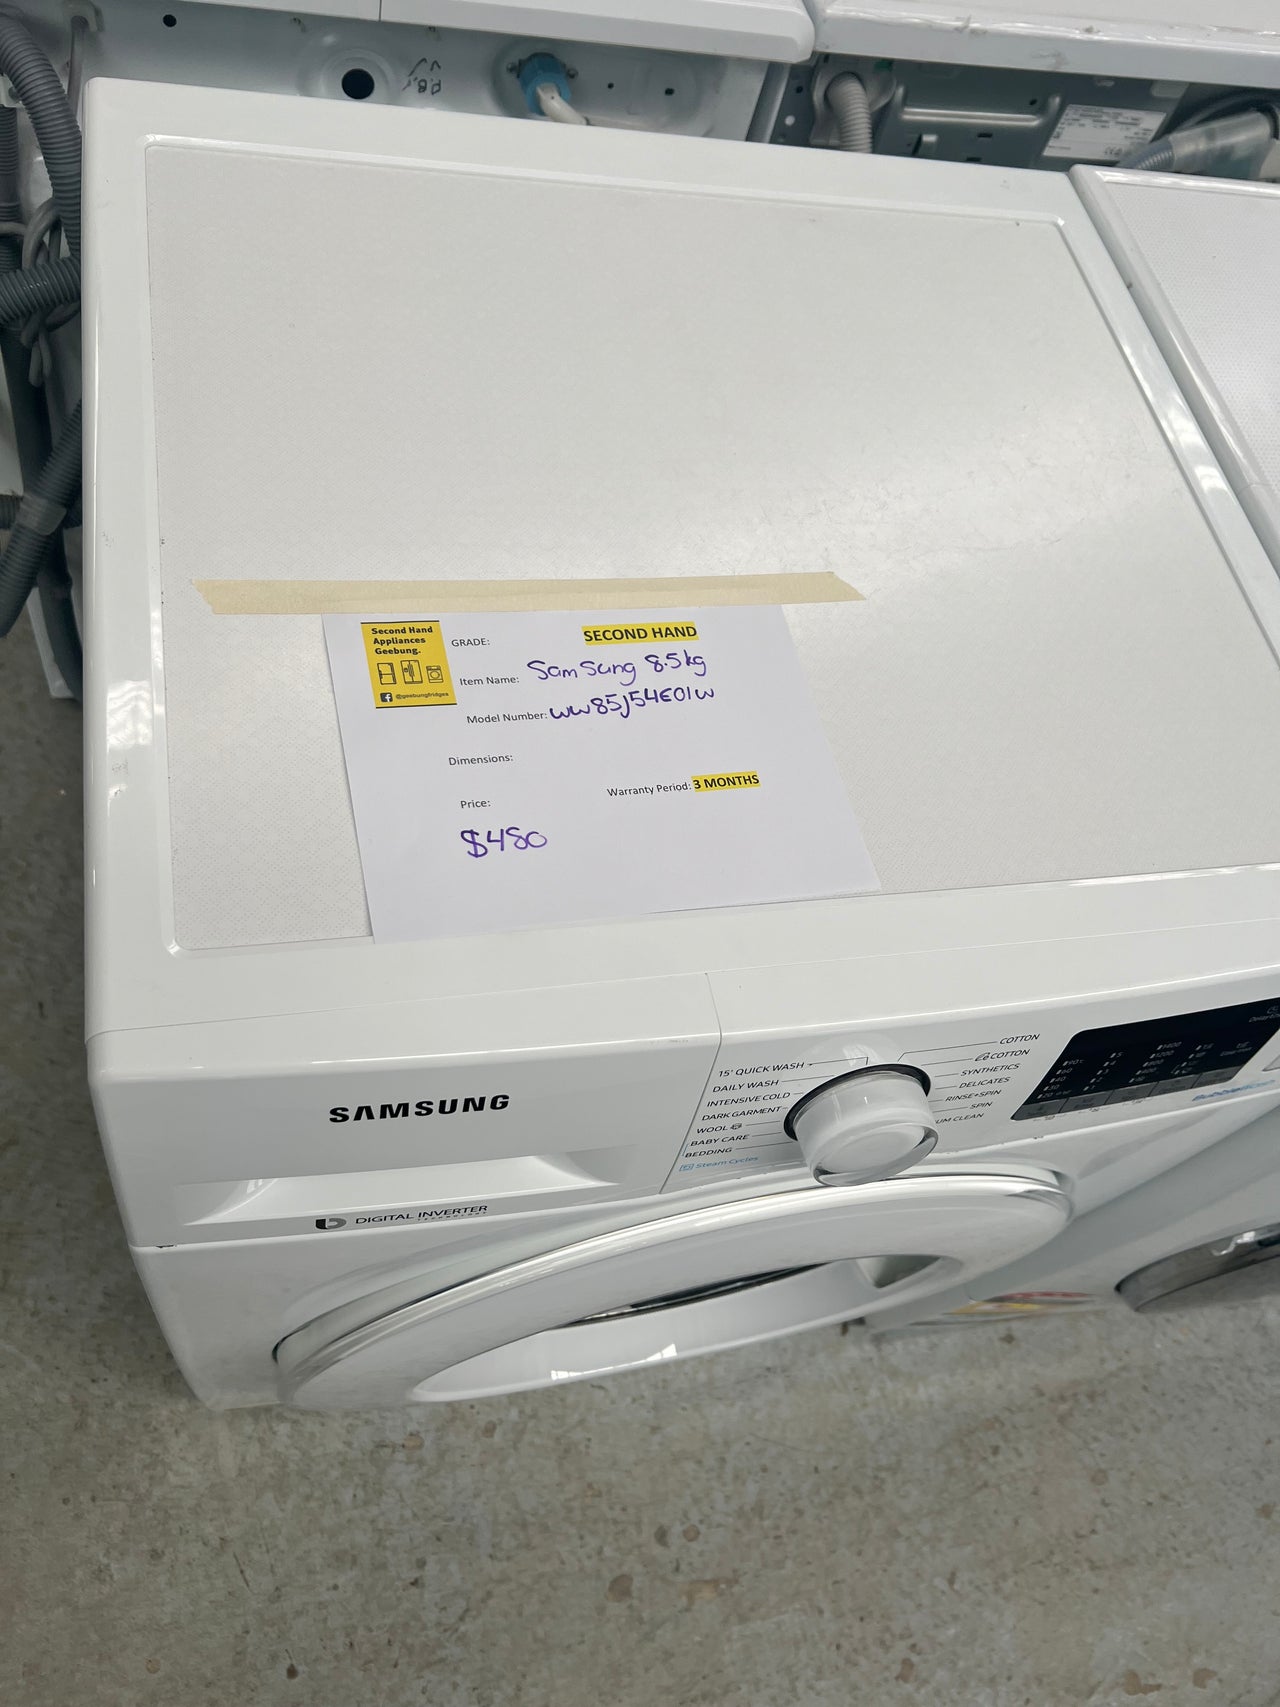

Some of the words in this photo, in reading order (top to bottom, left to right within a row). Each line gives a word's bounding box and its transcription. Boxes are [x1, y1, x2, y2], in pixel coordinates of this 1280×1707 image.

[371, 627, 407, 635] Second
[408, 626, 433, 634] Hand
[583, 627, 648, 642] SECOND
[651, 625, 697, 639] HAND
[373, 637, 426, 646] Appliances
[451, 638, 491, 647] GRADE:
[374, 647, 421, 656] Geebung.
[460, 677, 484, 687] Item
[486, 675, 520, 685] Name:
[467, 714, 501, 724] Model
[502, 711, 548, 722] Number:
[448, 753, 514, 766] Dimensions:
[606, 785, 654, 797] Warranty
[656, 781, 692, 793] Period:
[692, 779, 702, 790] 3
[703, 774, 759, 789] MONTHS
[460, 799, 491, 809] Price:
[460, 826, 548, 859] $480
[999, 1033, 1041, 1045] COTTON
[990, 1048, 1031, 1060] COTTON
[735, 1065, 770, 1076] QUICK
[772, 1061, 805, 1072] WASH
[960, 1063, 1021, 1077] SYNTHETICS
[712, 1083, 745, 1093] DAILY
[747, 1079, 780, 1089] WASH
[958, 1076, 1011, 1089] DELICATES
[706, 1094, 762, 1107] INTENSIVE
[762, 1092, 791, 1100] COLD
[945, 1089, 1002, 1102] RINSE+SPIN
[329, 1094, 510, 1123] SAMSUNG
[969, 1101, 993, 1110] SPIN
[701, 1112, 731, 1121] DARK
[731, 1106, 782, 1117] GARMENT
[935, 1117, 952, 1125] UM
[952, 1112, 985, 1122] CLEAN
[696, 1125, 728, 1134] WOOL
[690, 1137, 720, 1147] BABY
[721, 1134, 750, 1143] CARE
[684, 1147, 733, 1158] BEDDING
[695, 1160, 727, 1169] Steam
[728, 1156, 759, 1165] Cycles
[355, 1213, 414, 1225] DIGITAL
[418, 1205, 488, 1218] INVERTER
